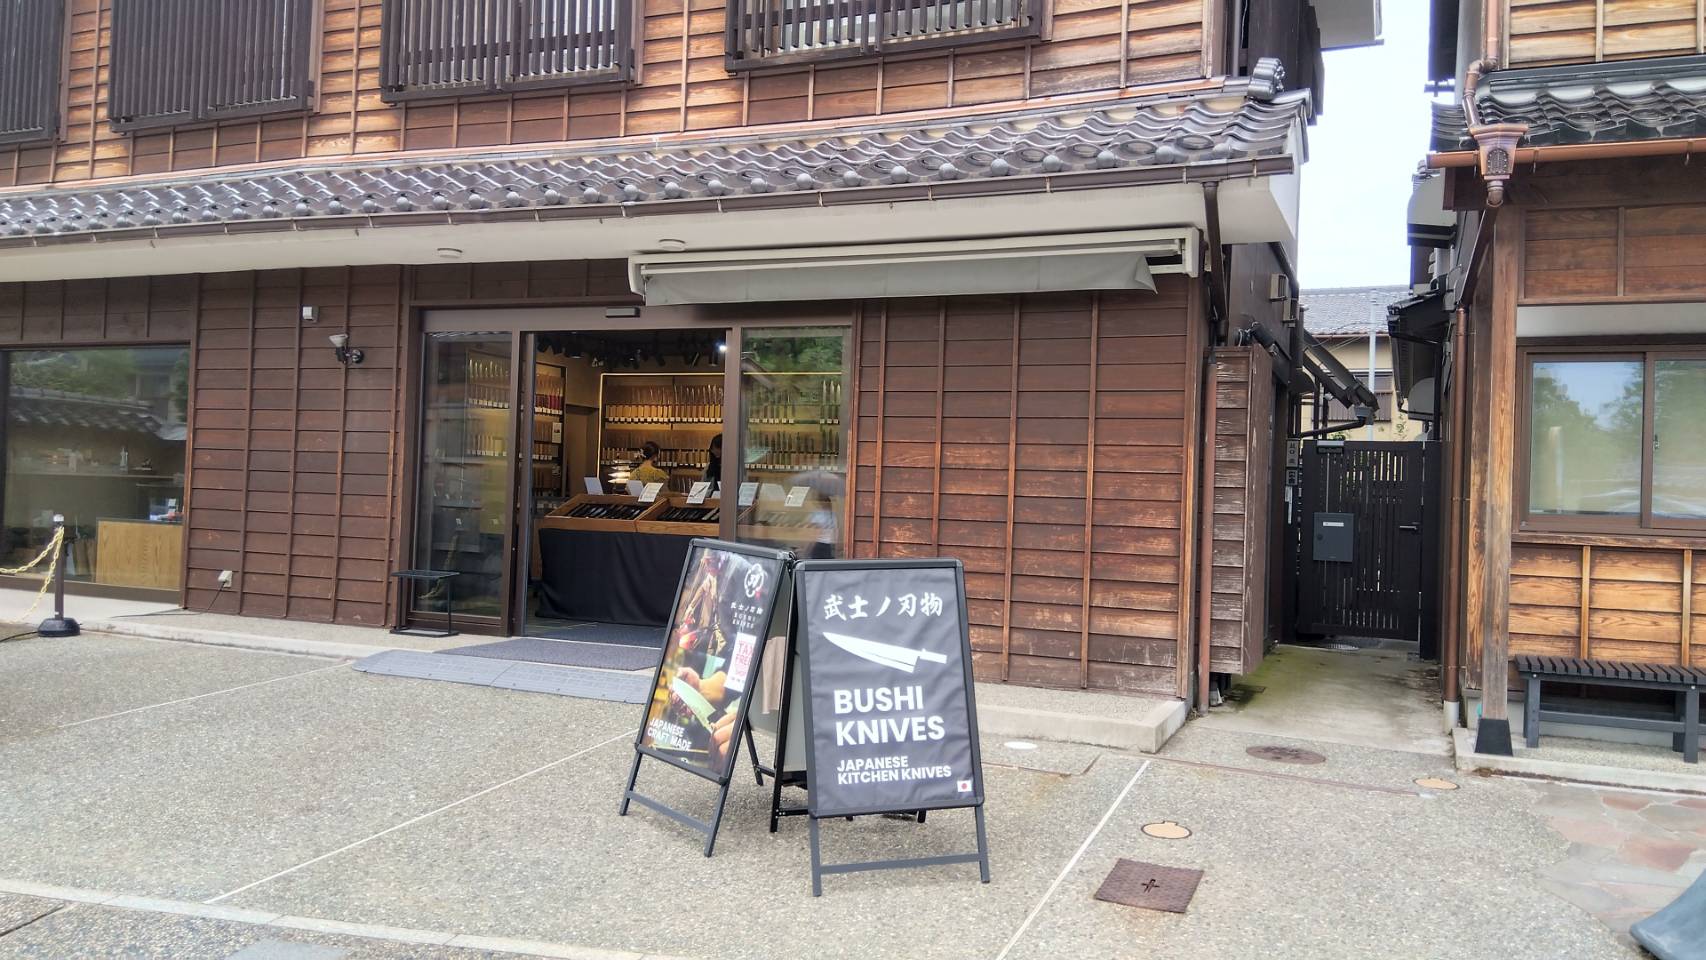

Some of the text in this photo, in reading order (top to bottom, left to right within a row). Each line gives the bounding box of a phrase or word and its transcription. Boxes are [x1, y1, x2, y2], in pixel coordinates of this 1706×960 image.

[823, 591, 943, 621] 武士ノ刃物
[834, 685, 924, 714] BUSHI
[647, 727, 693, 752] CRAFT MADE
[649, 717, 685, 737] JAPANESE
[835, 715, 946, 746] KNIVES
[836, 756, 909, 772] JAPANESE
[838, 765, 952, 785] KITCHEN KNIVES
